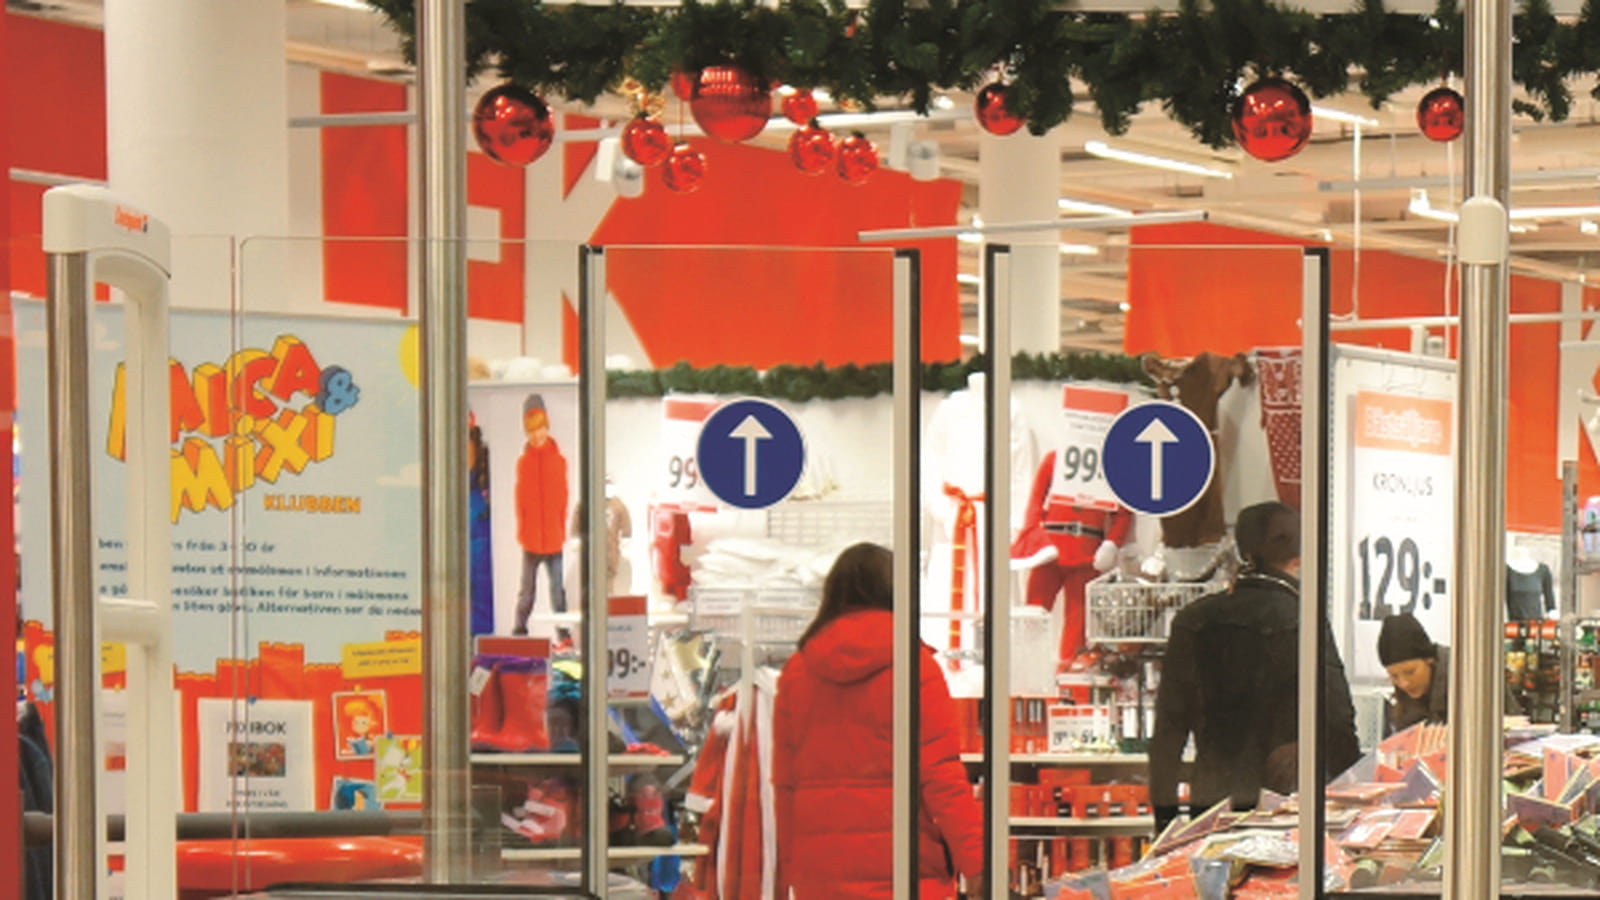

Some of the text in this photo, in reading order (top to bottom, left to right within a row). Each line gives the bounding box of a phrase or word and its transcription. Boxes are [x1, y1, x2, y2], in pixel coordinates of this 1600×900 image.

[316, 365, 361, 416] &
[1064, 445, 1102, 483] 99
[263, 494, 361, 514] KLUBBEN
[1358, 534, 1447, 621] 129:-
